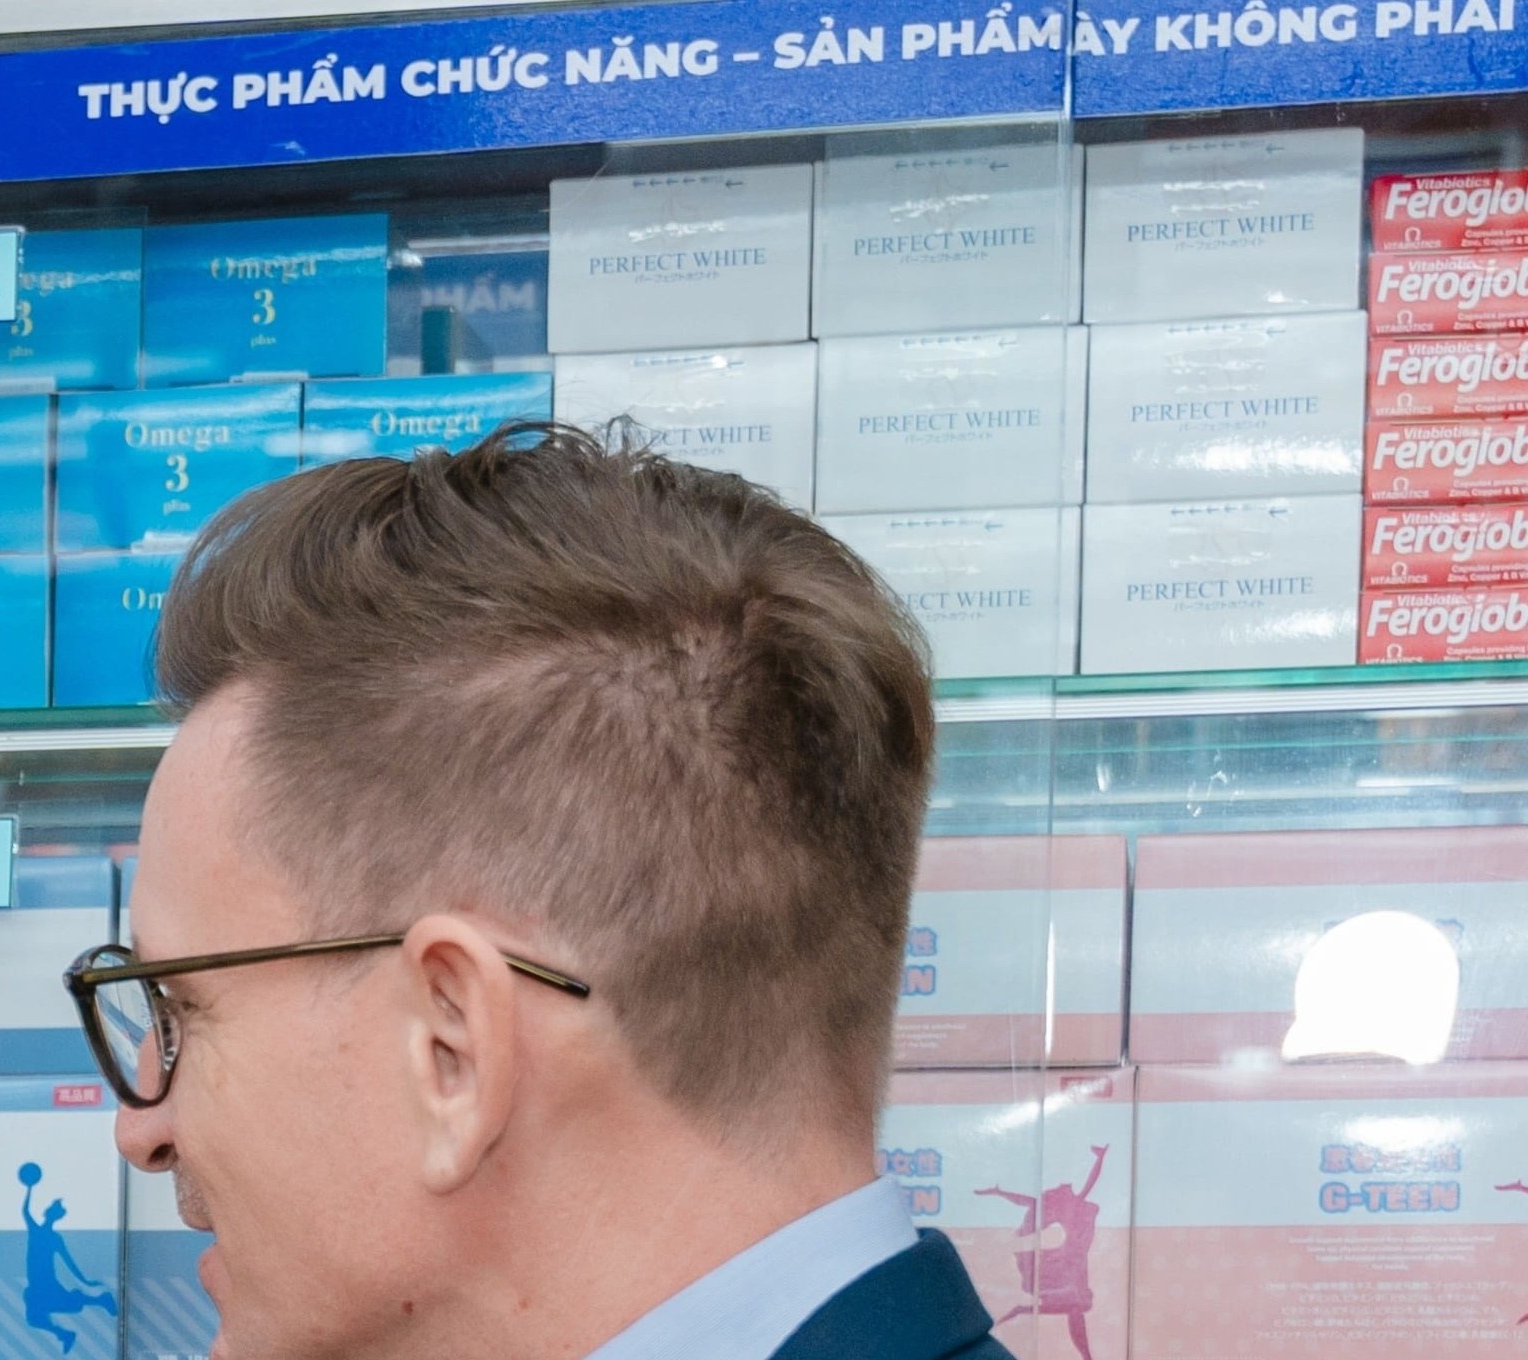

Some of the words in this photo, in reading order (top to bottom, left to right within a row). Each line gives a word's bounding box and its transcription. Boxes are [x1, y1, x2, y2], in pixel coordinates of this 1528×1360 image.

[78, 72, 217, 124] THỰC
[234, 54, 385, 109] PHẨM
[400, 46, 549, 99] CHỨC
[566, 36, 719, 86] NĂNG
[774, 6, 893, 71] SẢN
[902, 0, 1061, 62] PHẨM
[1075, 10, 1135, 58] ÀY
[1157, 3, 1360, 54] KHÔNG
[1384, 178, 1528, 227] Feroglo
[853, 231, 954, 256] PERFECT
[959, 225, 1037, 249] WHITE
[1127, 218, 1230, 242] PERFECT
[1238, 211, 1315, 234] WHITE
[1131, 400, 1235, 423] PERFECT
[1242, 396, 1320, 418] WHITE
[123, 420, 233, 453] Omega
[164, 454, 191, 493] 3
[1319, 1181, 1462, 1214] G-TEEN
